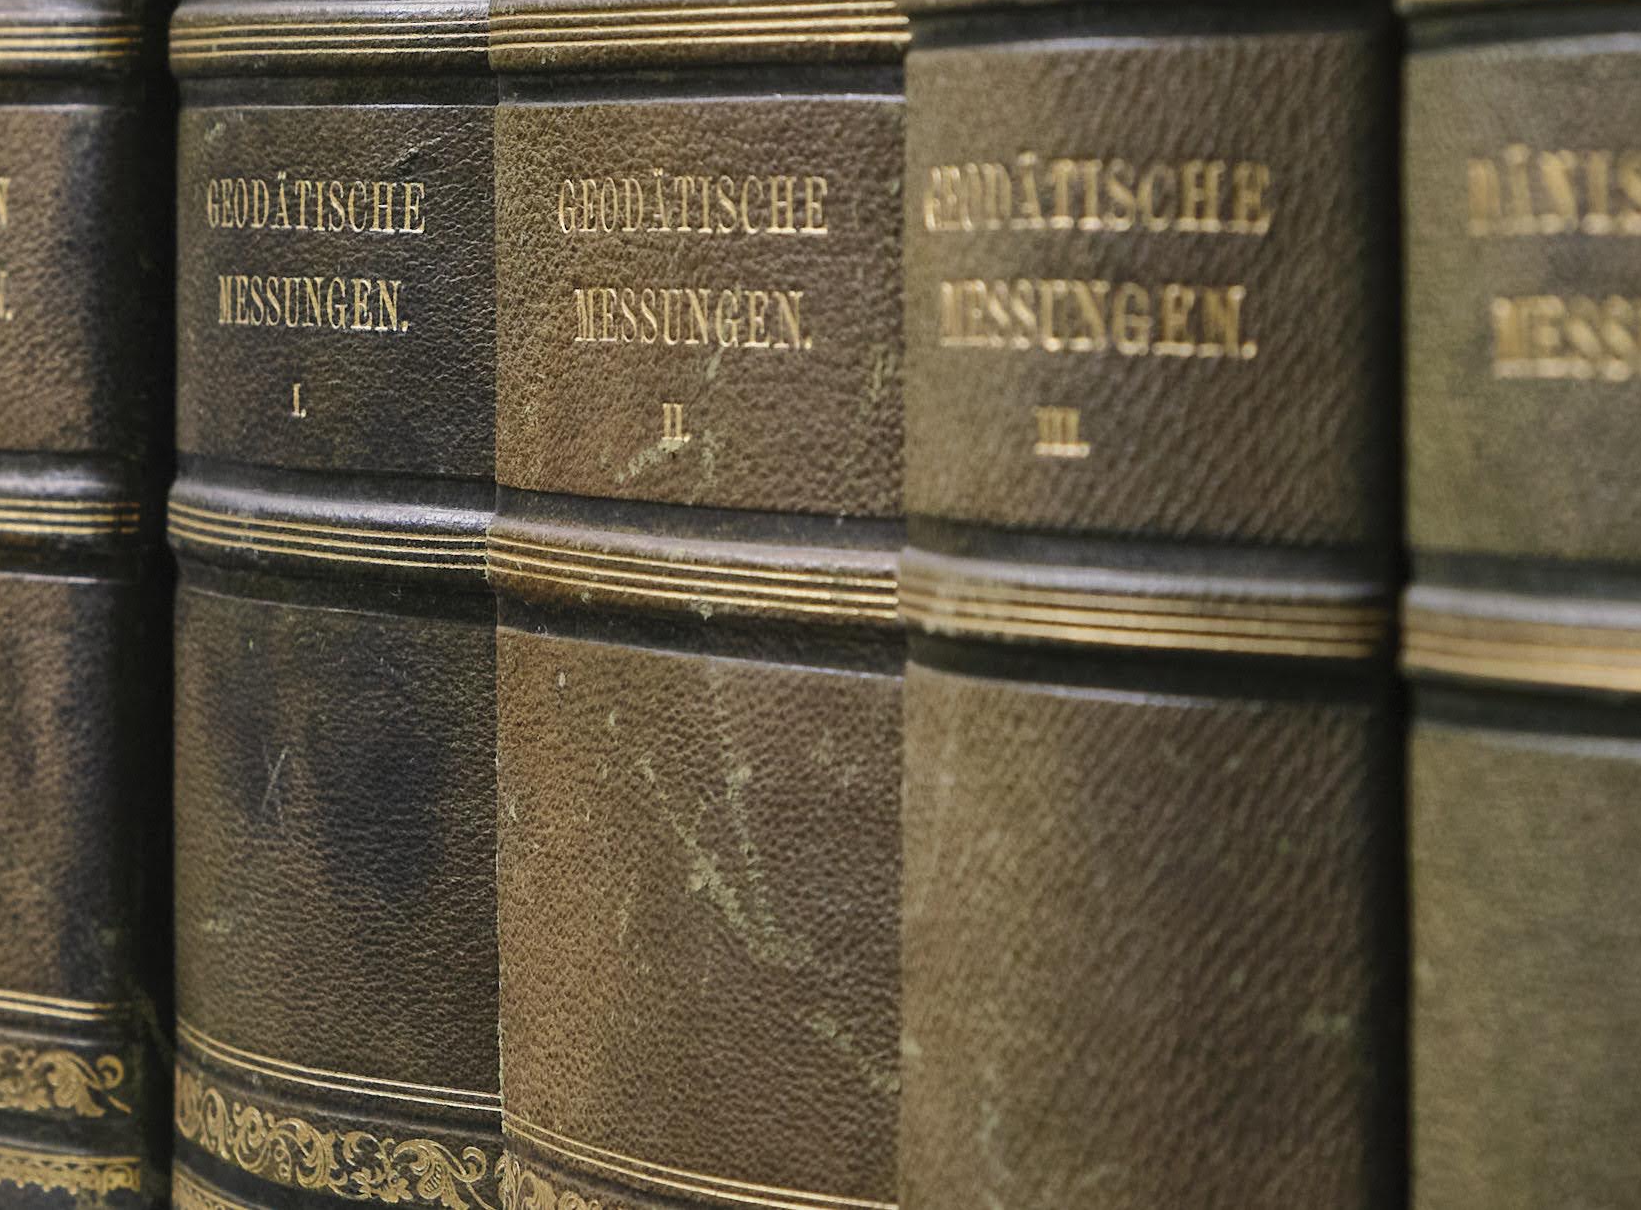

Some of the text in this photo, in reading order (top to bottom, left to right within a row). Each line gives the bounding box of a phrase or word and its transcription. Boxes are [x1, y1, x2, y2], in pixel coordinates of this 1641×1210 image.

[206, 171, 427, 235] GEODÄTISCHE
[557, 167, 830, 236] GEODÄTISCHE
[217, 275, 411, 332] MESSUNGEN.
[573, 287, 815, 351] MESSUNGEN.
[292, 382, 308, 419] I.
